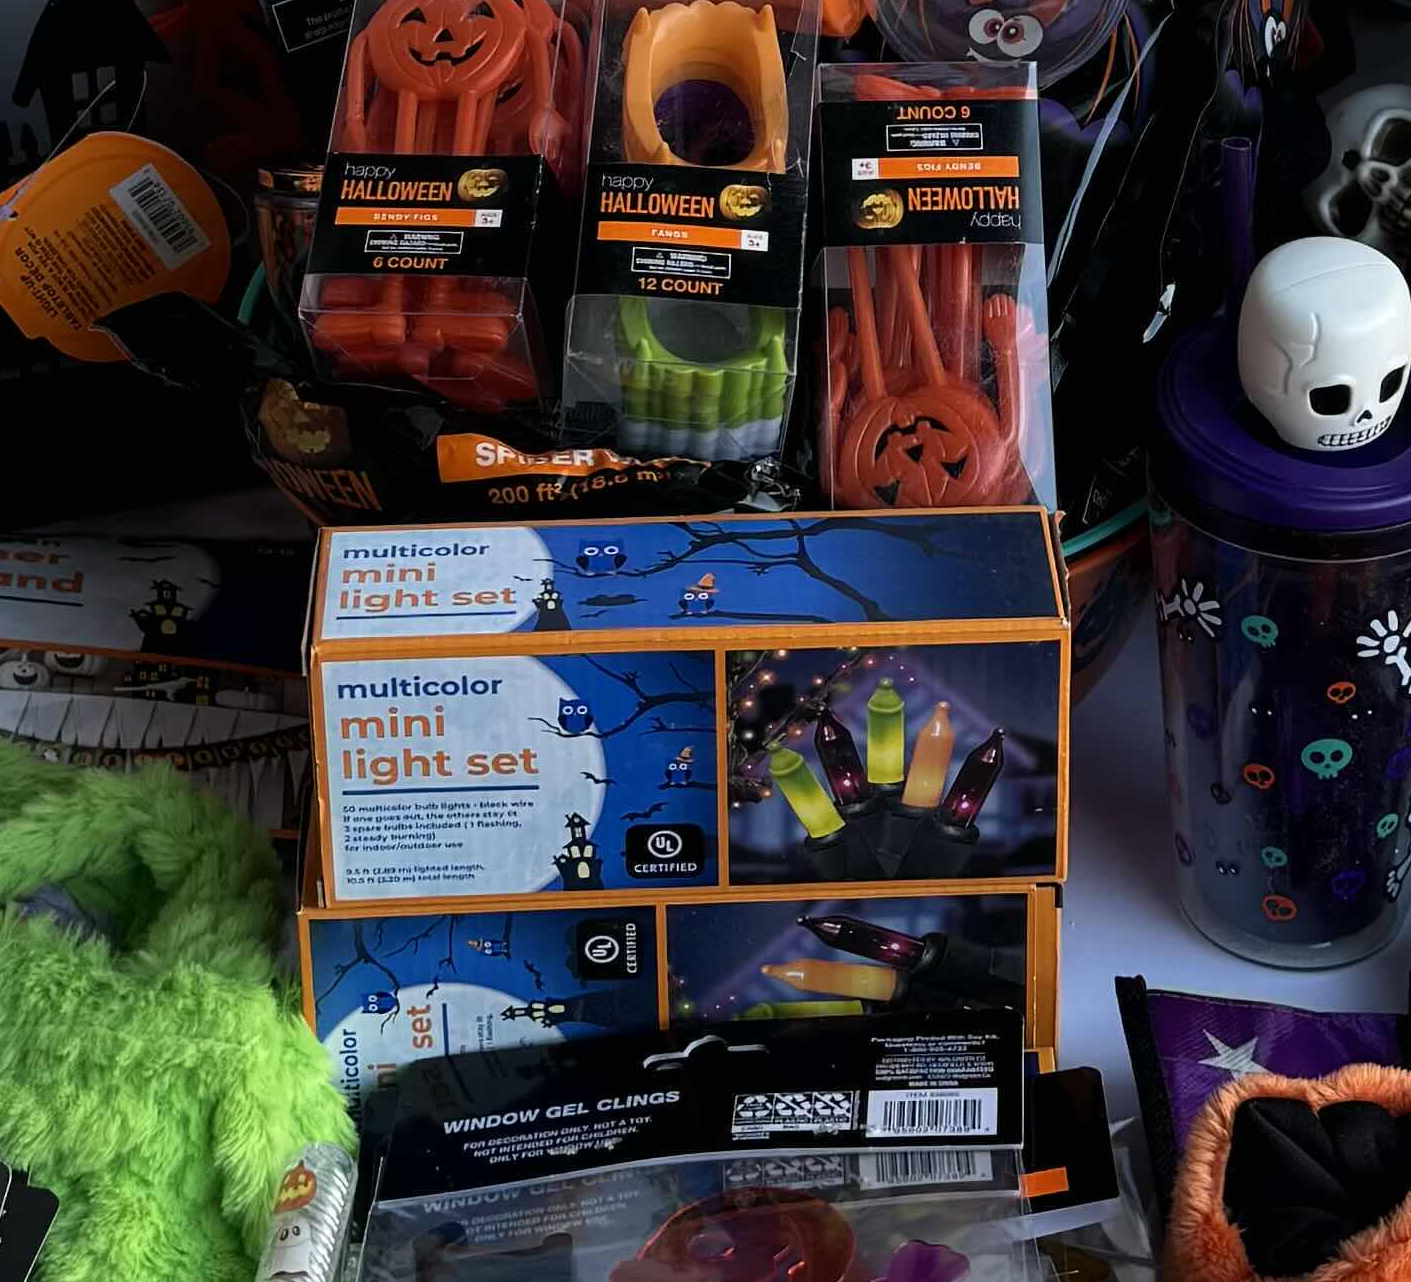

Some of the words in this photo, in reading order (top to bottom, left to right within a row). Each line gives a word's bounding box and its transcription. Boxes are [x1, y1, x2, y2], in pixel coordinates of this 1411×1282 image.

[897, 106, 957, 120] COUNT
[961, 106, 971, 118] 6
[345, 161, 396, 179] happy
[340, 179, 453, 202] HALLOWEEN
[601, 173, 654, 192] happy
[600, 191, 715, 218] HALLOWEEN
[908, 186, 1020, 211] HALLOWEEN
[970, 211, 1021, 230] happy
[651, 228, 688, 238] FANGS
[373, 256, 384, 268] 6
[388, 257, 449, 270] COUNT
[638, 277, 657, 290] 12
[661, 278, 724, 295] COUNT
[489, 485, 529, 504] 200
[343, 541, 490, 560] multicolor
[342, 563, 437, 584] mini
[339, 587, 438, 615] light
[451, 587, 517, 608] set
[338, 675, 503, 699] multicolor
[341, 705, 445, 739] mini
[342, 748, 453, 786] light
[466, 748, 540, 776] set
[358, 803, 412, 814] multicolor
[414, 802, 438, 811] bulb
[441, 801, 471, 813] lights
[479, 800, 508, 809] black
[510, 800, 534, 808] wire
[353, 815, 373, 823] one
[376, 815, 401, 824] goes
[415, 820, 462, 830] included
[655, 836, 674, 852] UL
[634, 861, 698, 874] CERTIFIED
[626, 923, 637, 974] CERTIFIED
[406, 1004, 434, 1050] set
[443, 1108, 540, 1135] WINDOW
[545, 1103, 589, 1120] GEL
[596, 1090, 681, 1111] CLINGS
[488, 1128, 559, 1148] DECORATION
[499, 1138, 554, 1154] INTENDED
[556, 1134, 579, 1145] FOR
